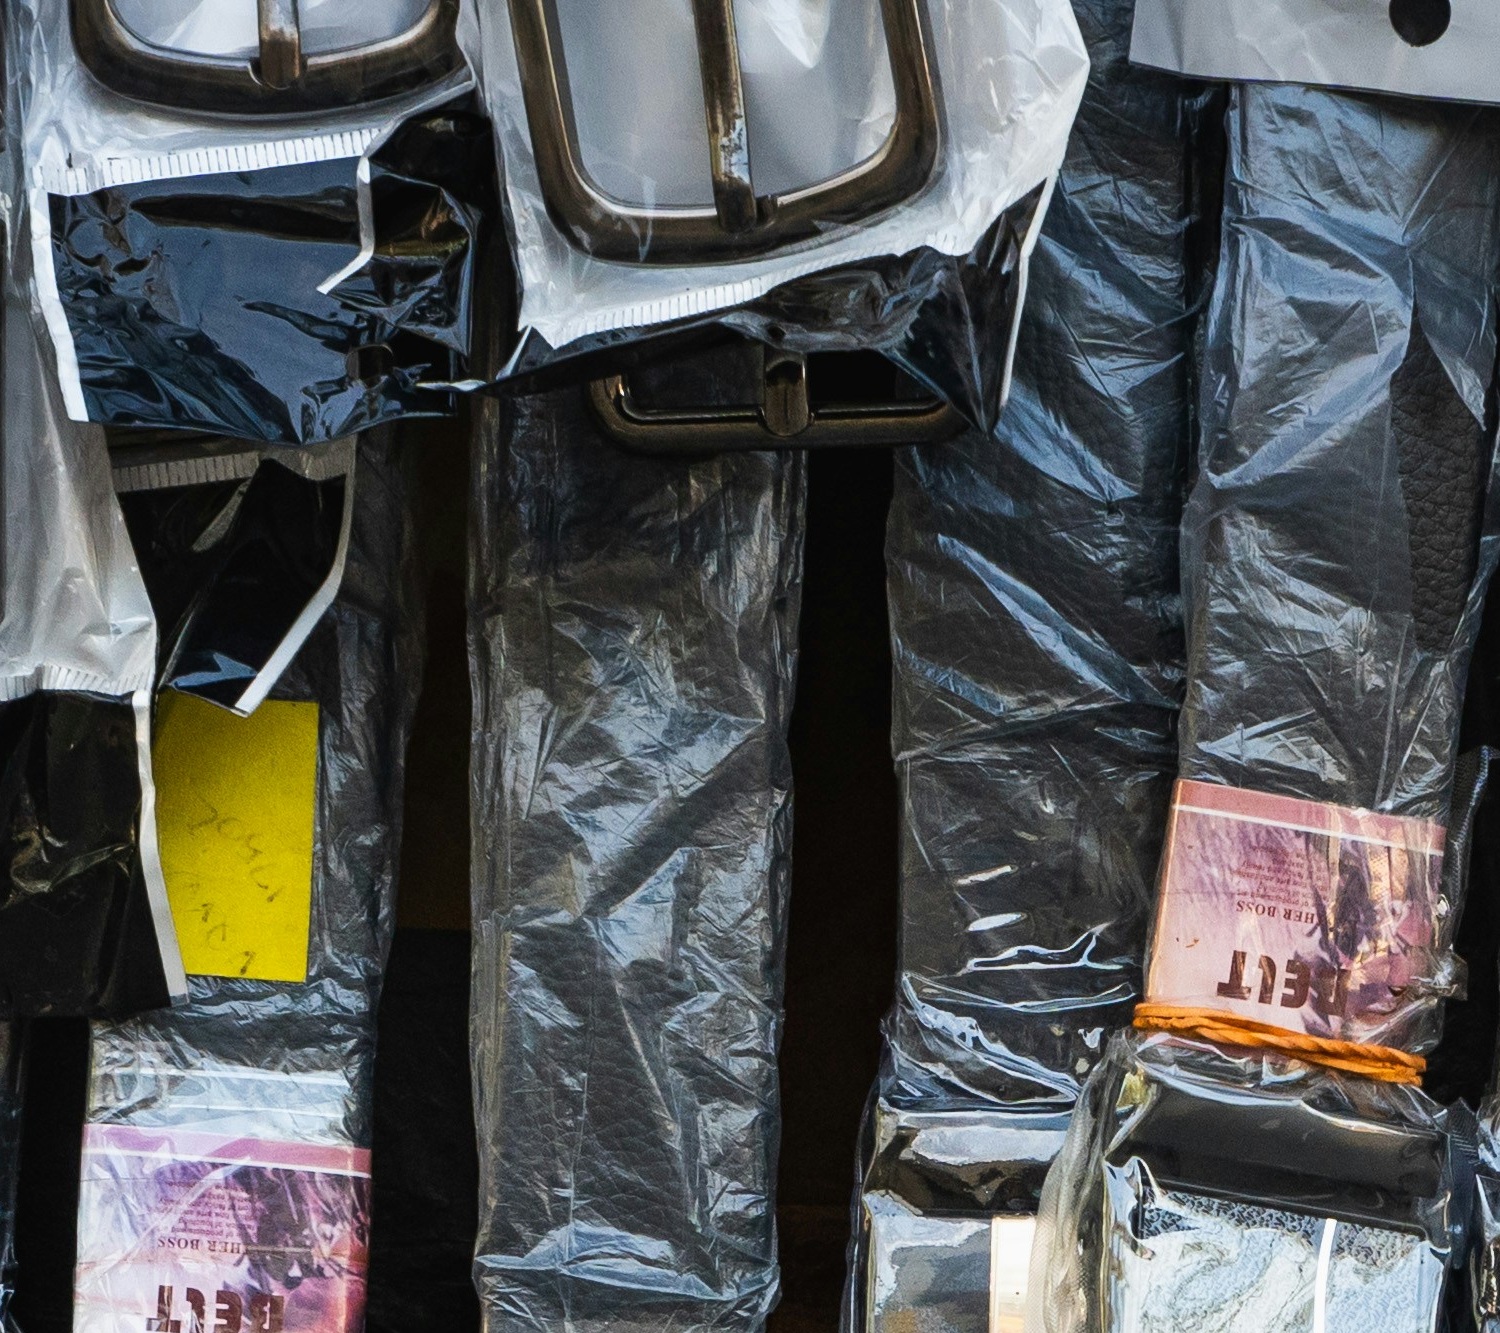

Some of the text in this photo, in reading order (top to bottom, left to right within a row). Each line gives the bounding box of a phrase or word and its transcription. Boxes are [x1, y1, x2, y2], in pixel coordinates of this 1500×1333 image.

[1235, 901, 1277, 918] BOSS
[1216, 950, 1348, 1016] BELT
[157, 1237, 200, 1251] BOSS
